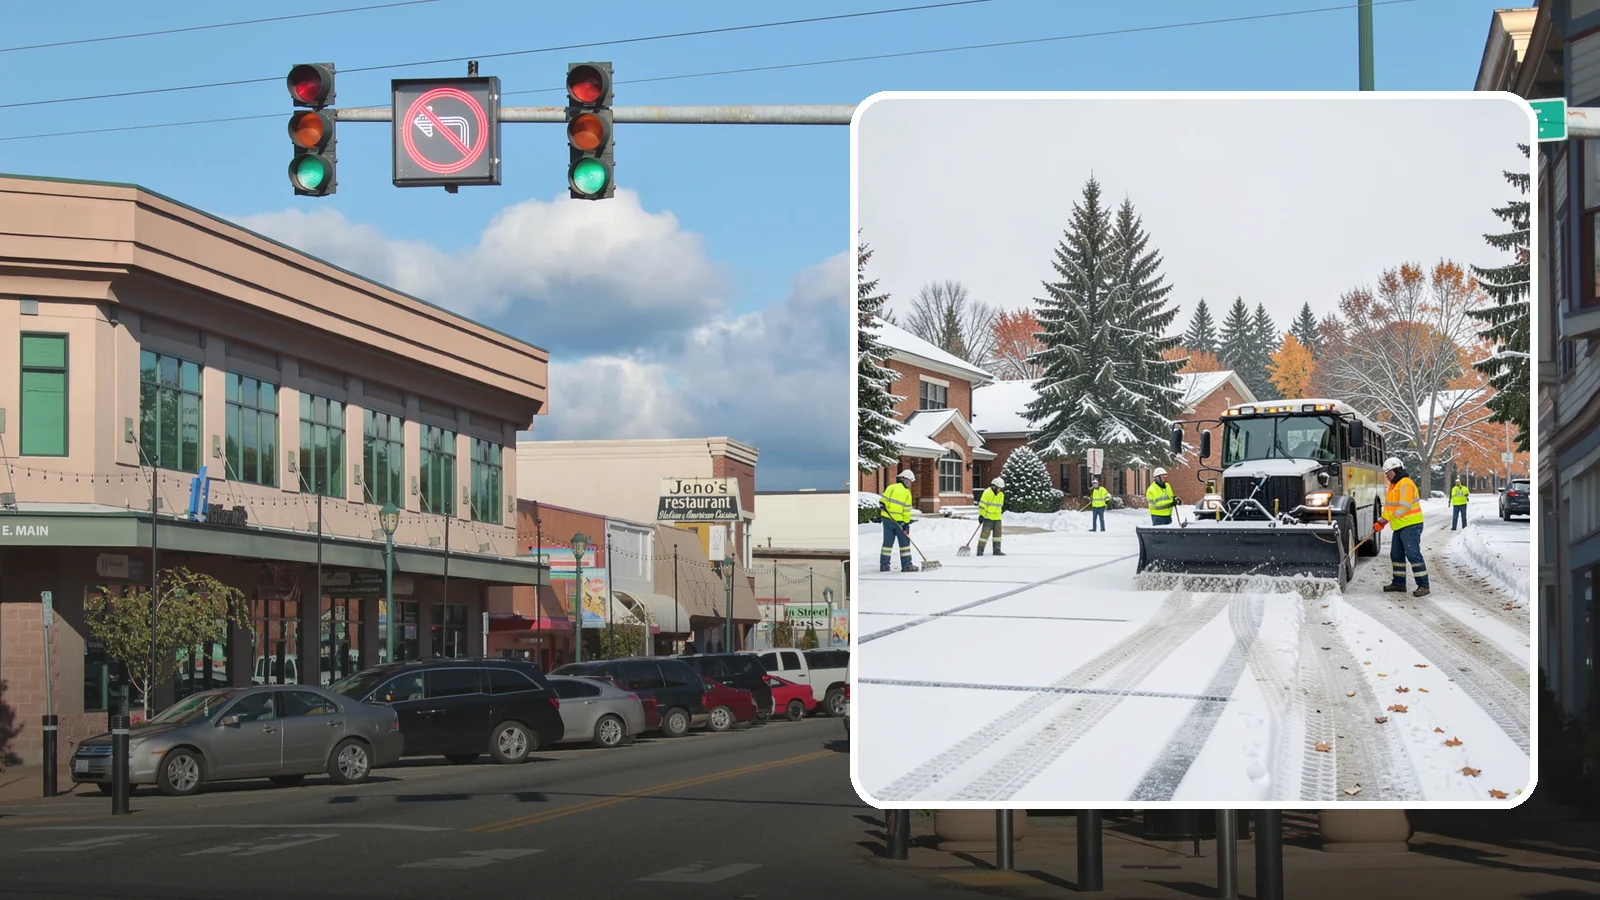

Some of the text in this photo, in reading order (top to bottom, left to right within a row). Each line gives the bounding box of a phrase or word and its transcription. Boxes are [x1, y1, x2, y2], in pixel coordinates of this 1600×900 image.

[670, 480, 728, 494] Jeno's
[665, 496, 731, 509] restaurant
[658, 509, 682, 519] Italian
[686, 509, 714, 519] American
[715, 509, 738, 519] Cuisine
[2, 525, 49, 536] E. MAIN
[786, 608, 795, 616] in
[797, 608, 828, 616] Street
